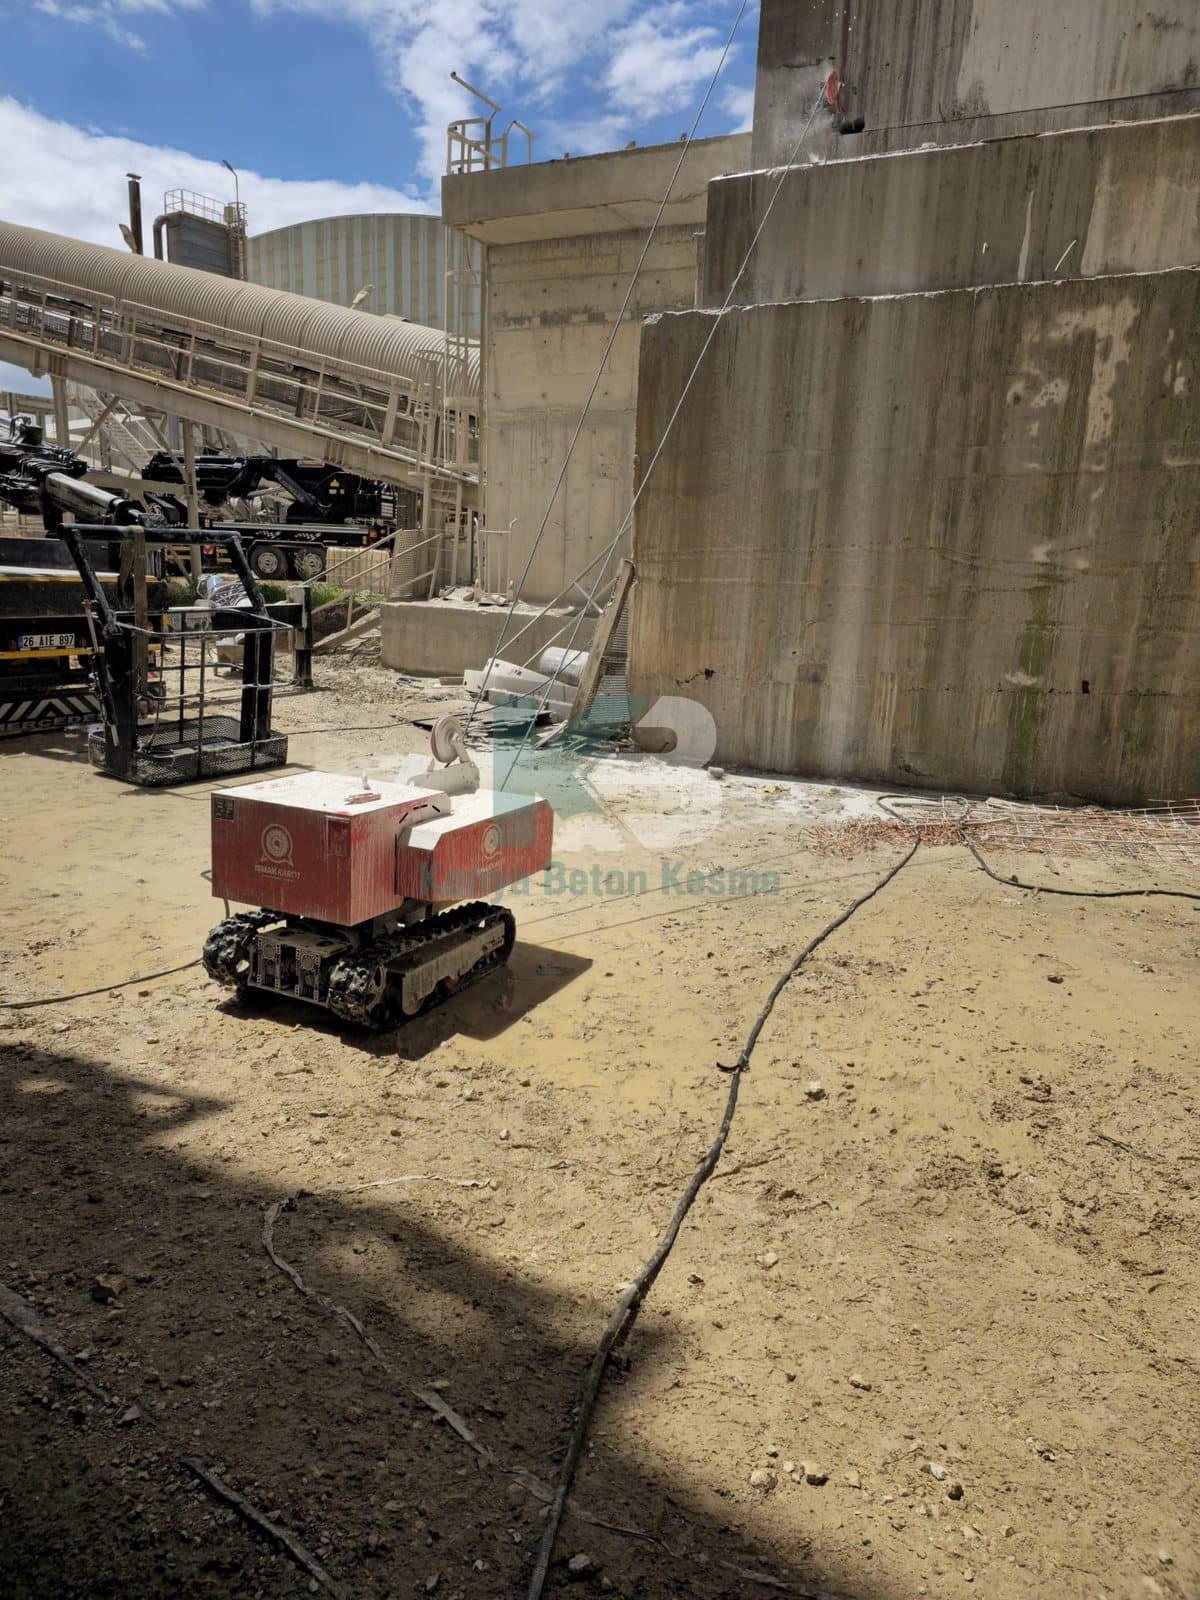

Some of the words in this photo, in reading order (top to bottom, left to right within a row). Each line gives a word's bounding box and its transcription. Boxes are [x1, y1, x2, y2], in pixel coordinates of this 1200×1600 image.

[23, 637, 34, 647] 26
[40, 636, 55, 646] AIE
[60, 634, 74, 645] 897
